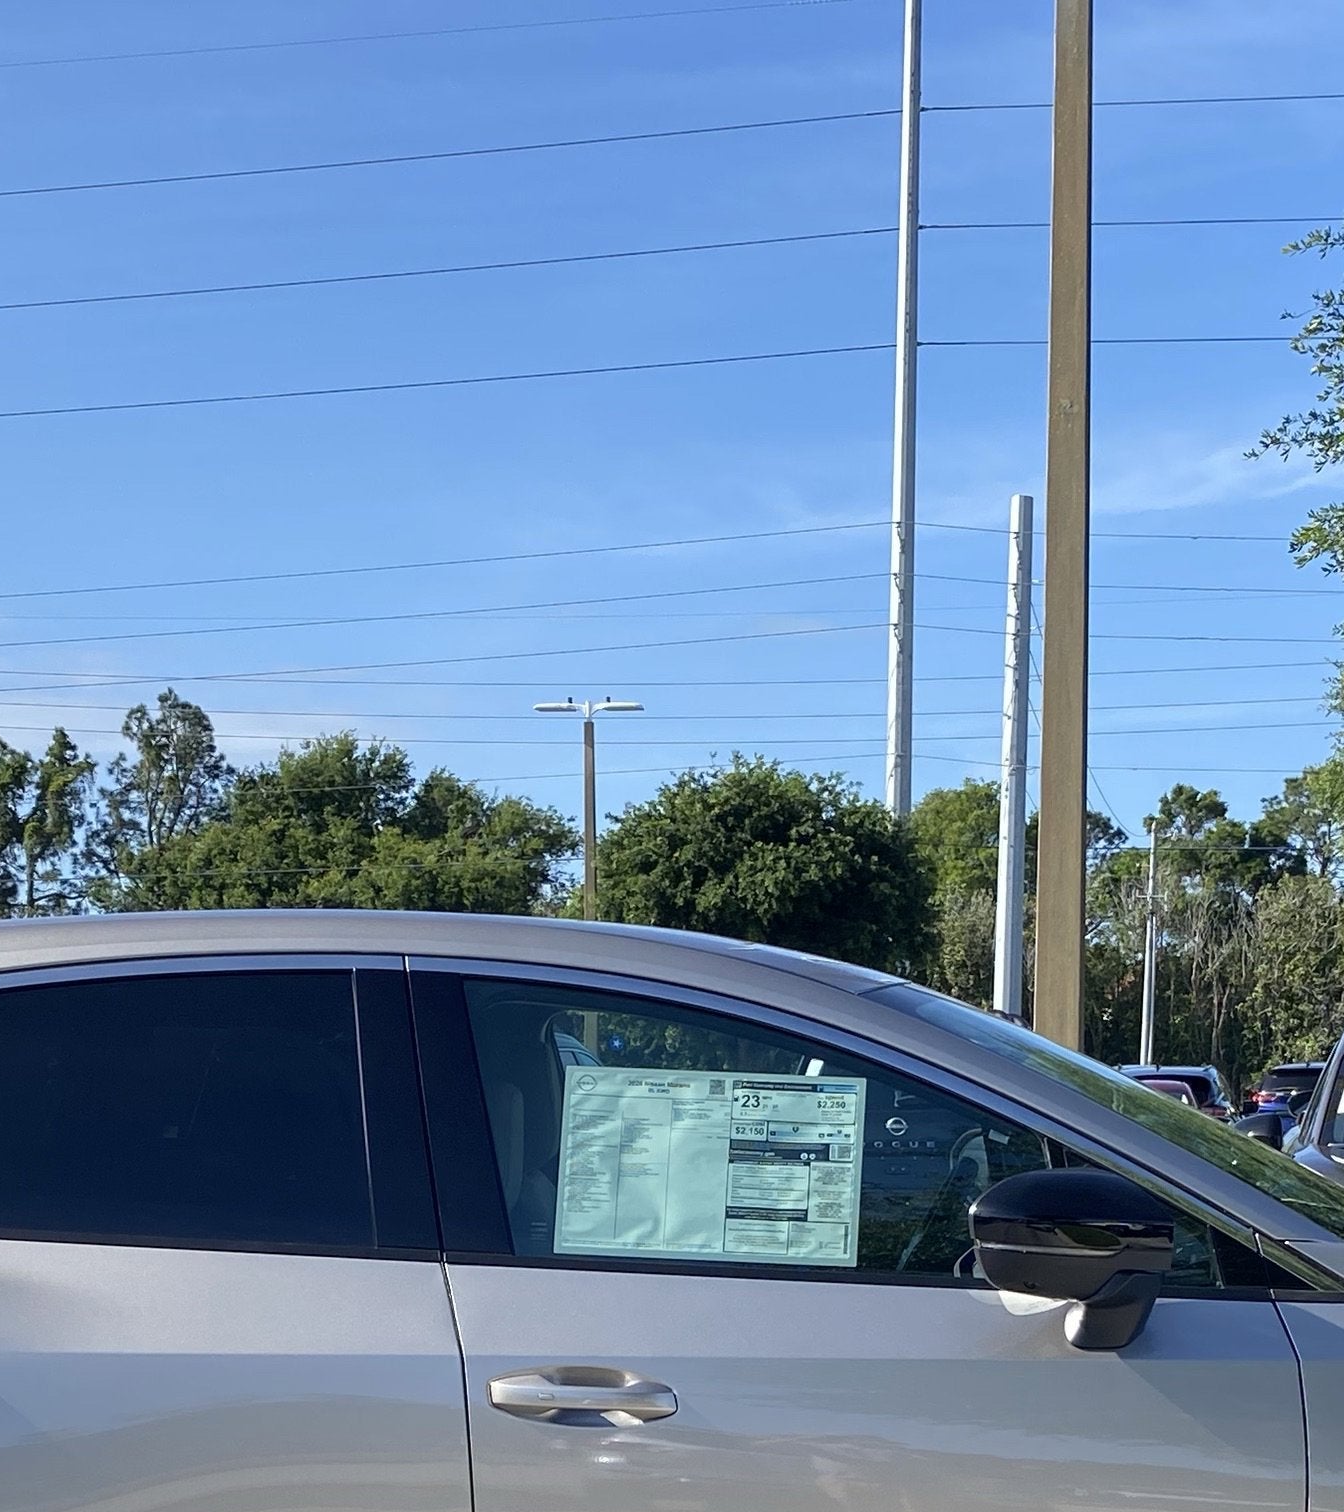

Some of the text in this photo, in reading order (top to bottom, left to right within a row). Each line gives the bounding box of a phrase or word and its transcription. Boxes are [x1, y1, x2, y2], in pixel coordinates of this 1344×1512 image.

[741, 1094, 761, 1109] 23
[817, 1100, 846, 1109] $2,250
[863, 1141, 935, 1149] OGUE
